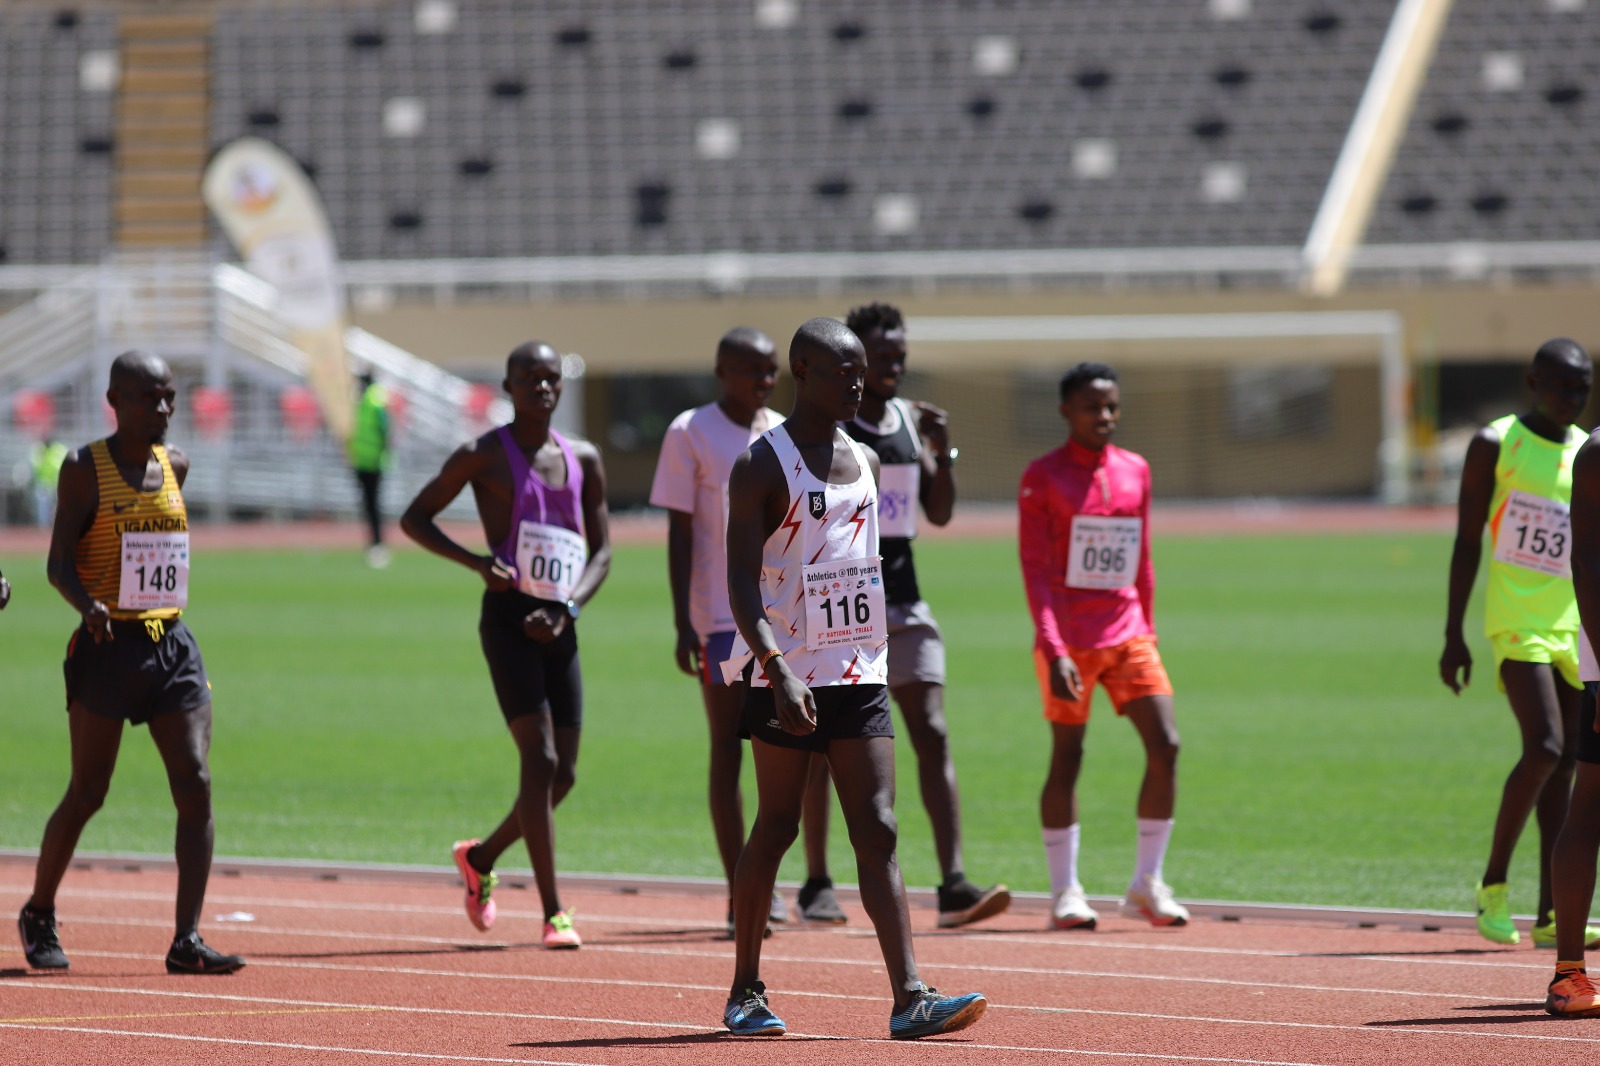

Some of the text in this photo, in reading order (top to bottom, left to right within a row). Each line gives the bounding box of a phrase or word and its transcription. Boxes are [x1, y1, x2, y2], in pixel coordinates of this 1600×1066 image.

[1516, 524, 1566, 559] 153
[531, 554, 573, 586] 001
[1083, 546, 1127, 573] 096
[135, 565, 177, 592] 148
[806, 570, 837, 583] Athletics
[859, 565, 878, 576] years
[819, 592, 870, 629] 116
[826, 629, 852, 638] NATIONAL
[855, 625, 873, 634] TRIALS
